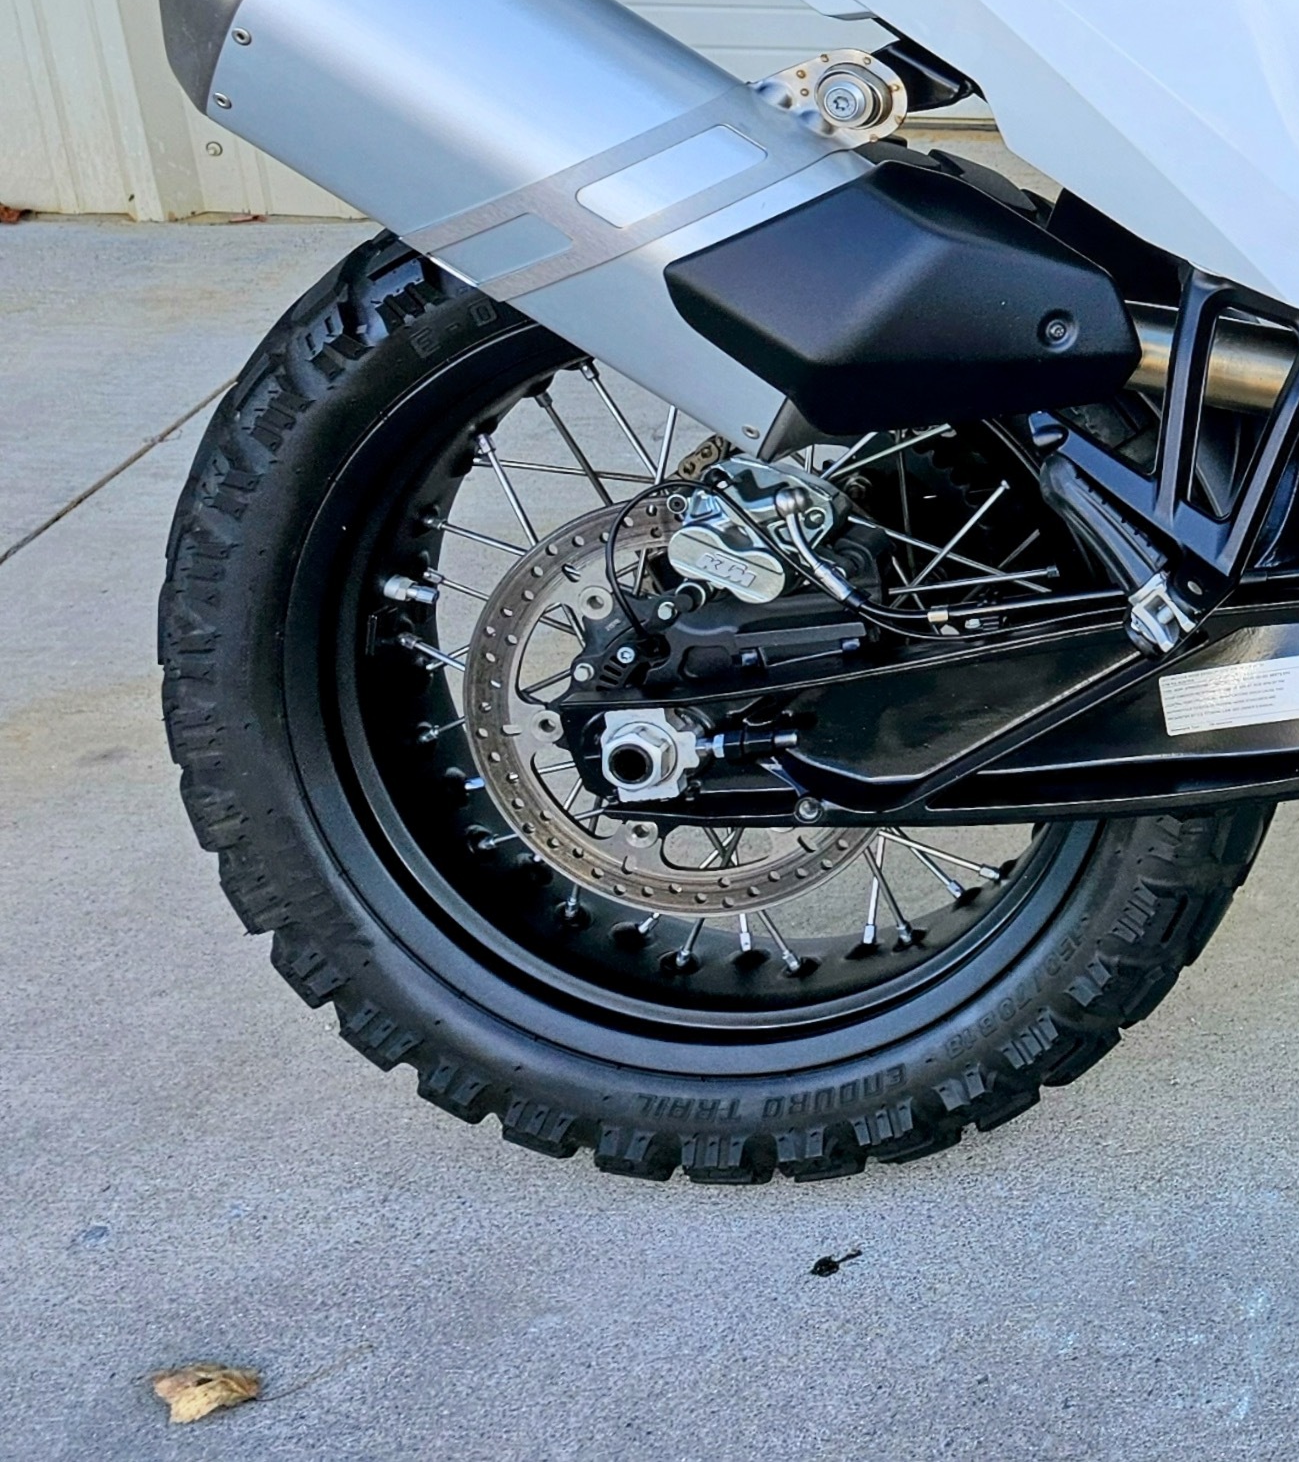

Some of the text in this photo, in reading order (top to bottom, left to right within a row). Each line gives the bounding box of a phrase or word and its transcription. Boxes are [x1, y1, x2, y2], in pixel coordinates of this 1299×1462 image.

[697, 552, 757, 587] KTM
[636, 1061, 907, 1125] ENDURO TRAIL
